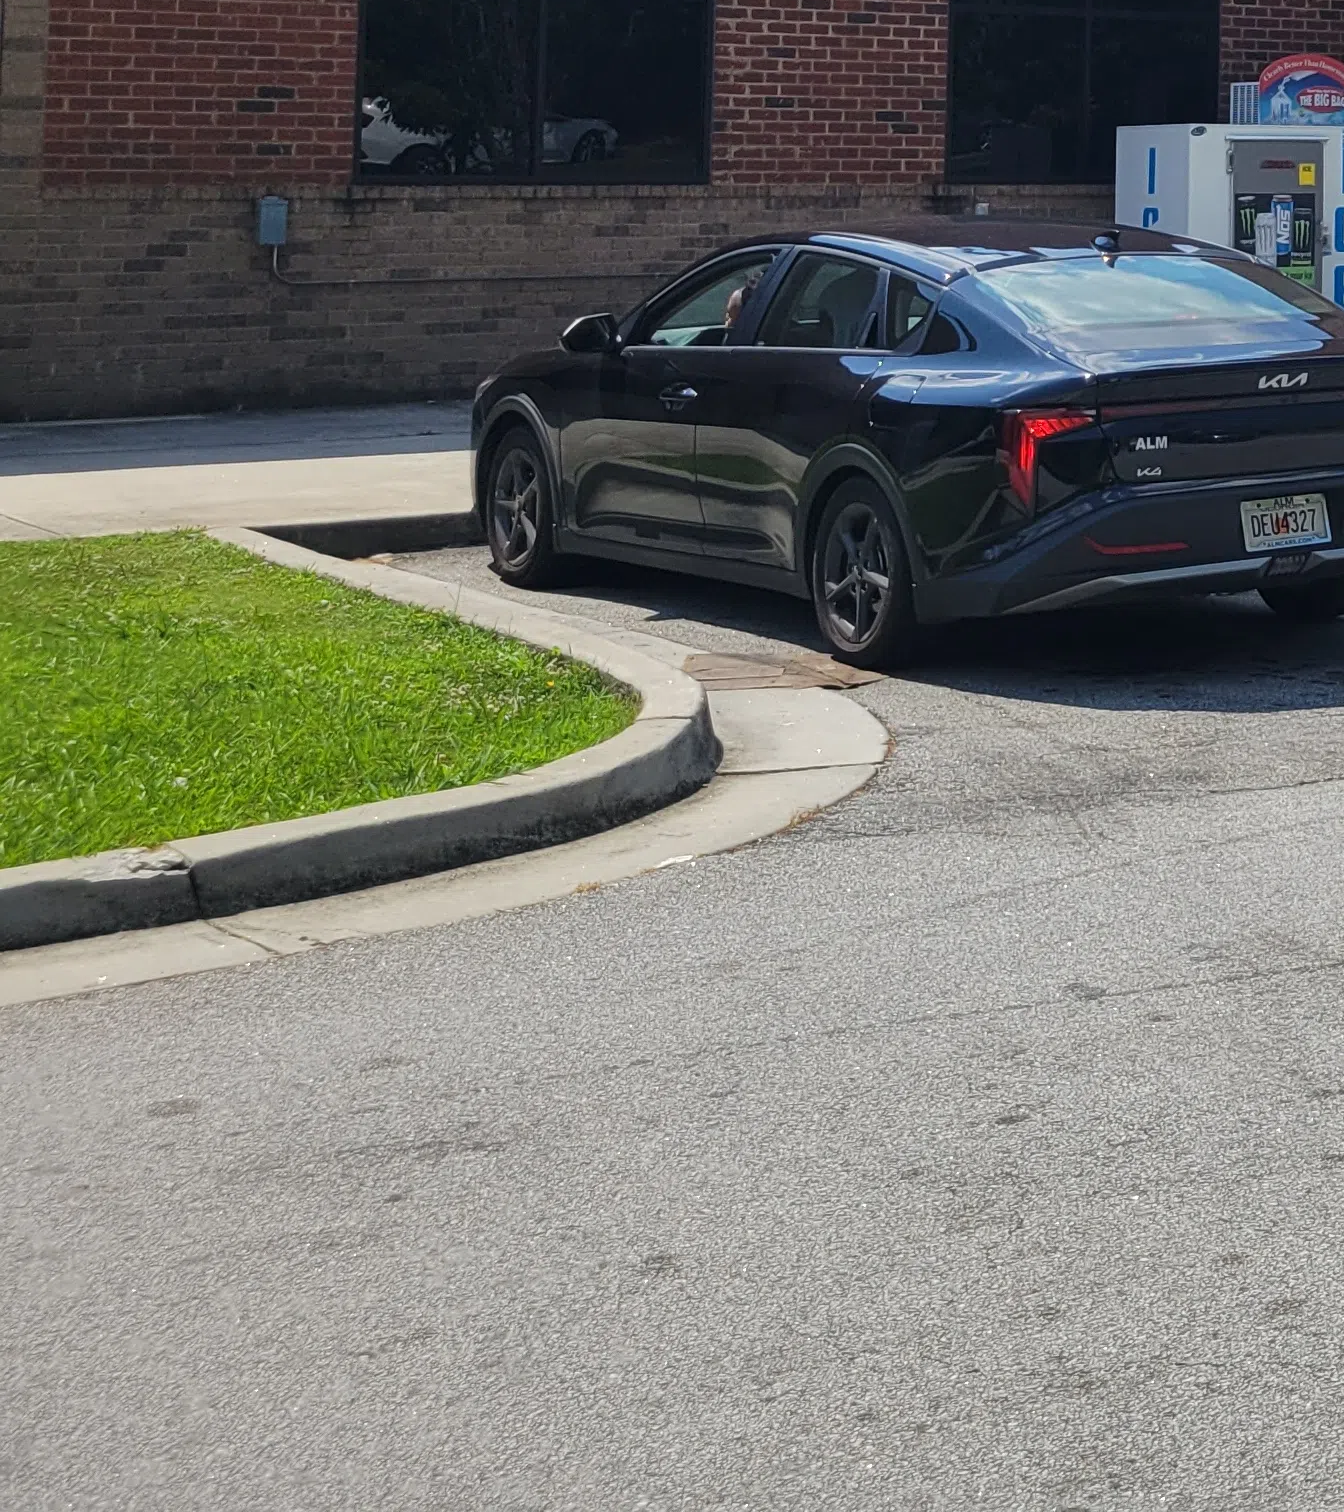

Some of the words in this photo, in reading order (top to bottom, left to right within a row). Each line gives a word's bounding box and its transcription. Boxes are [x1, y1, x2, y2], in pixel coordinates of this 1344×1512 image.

[1300, 95, 1312, 106] THE
[1314, 93, 1330, 106] BIG
[1276, 205, 1290, 245] NOS
[1135, 436, 1168, 451] ALM
[1136, 466, 1162, 477] K4
[1273, 497, 1295, 509] ALM
[1250, 508, 1316, 538] DEU4327
